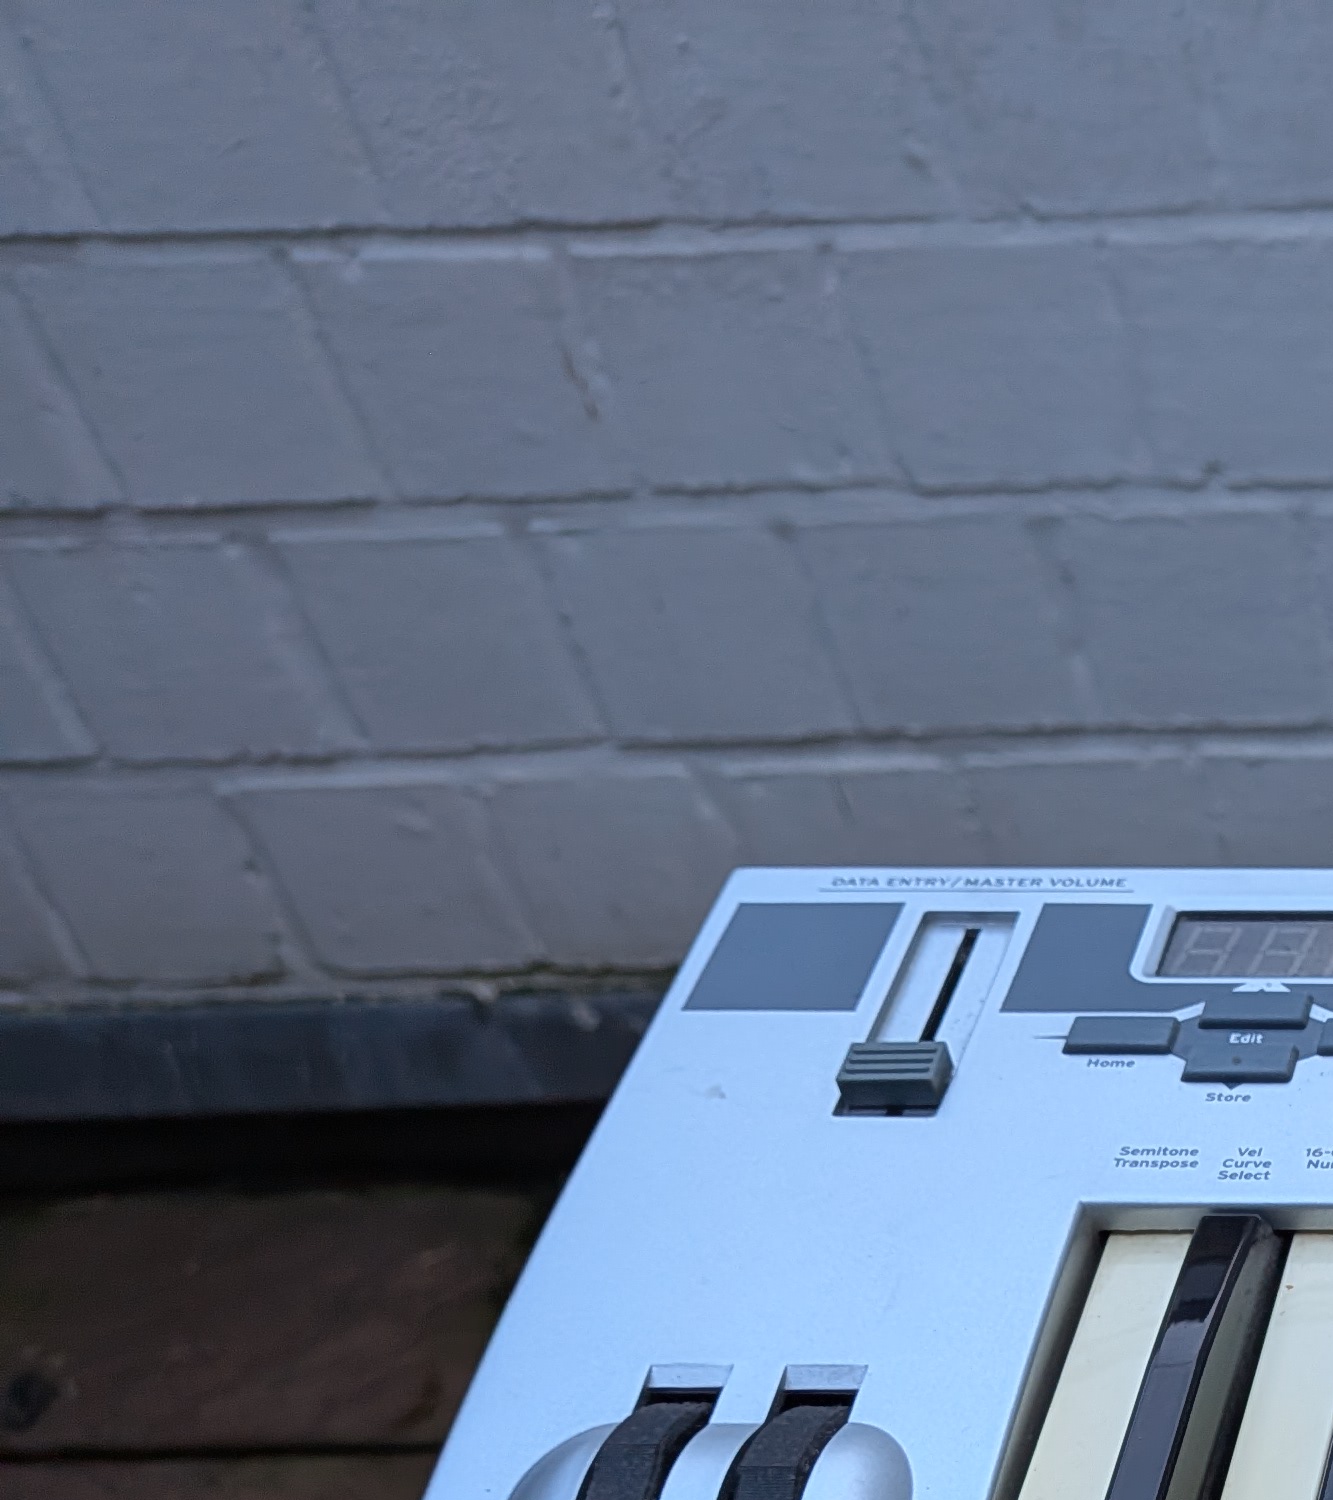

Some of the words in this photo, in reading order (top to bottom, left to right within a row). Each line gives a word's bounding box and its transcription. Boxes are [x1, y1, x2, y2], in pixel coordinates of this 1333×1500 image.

[1049, 876, 1128, 889] VOLUME
[1228, 1032, 1263, 1045] Edit
[1086, 1057, 1136, 1069] Home
[1205, 1091, 1252, 1104] Store
[1118, 1145, 1200, 1158] Semitone
[1237, 1146, 1264, 1158] Vel
[1112, 1157, 1200, 1171] Transpose
[1221, 1158, 1273, 1169] Curve
[1217, 1168, 1272, 1181] Select
